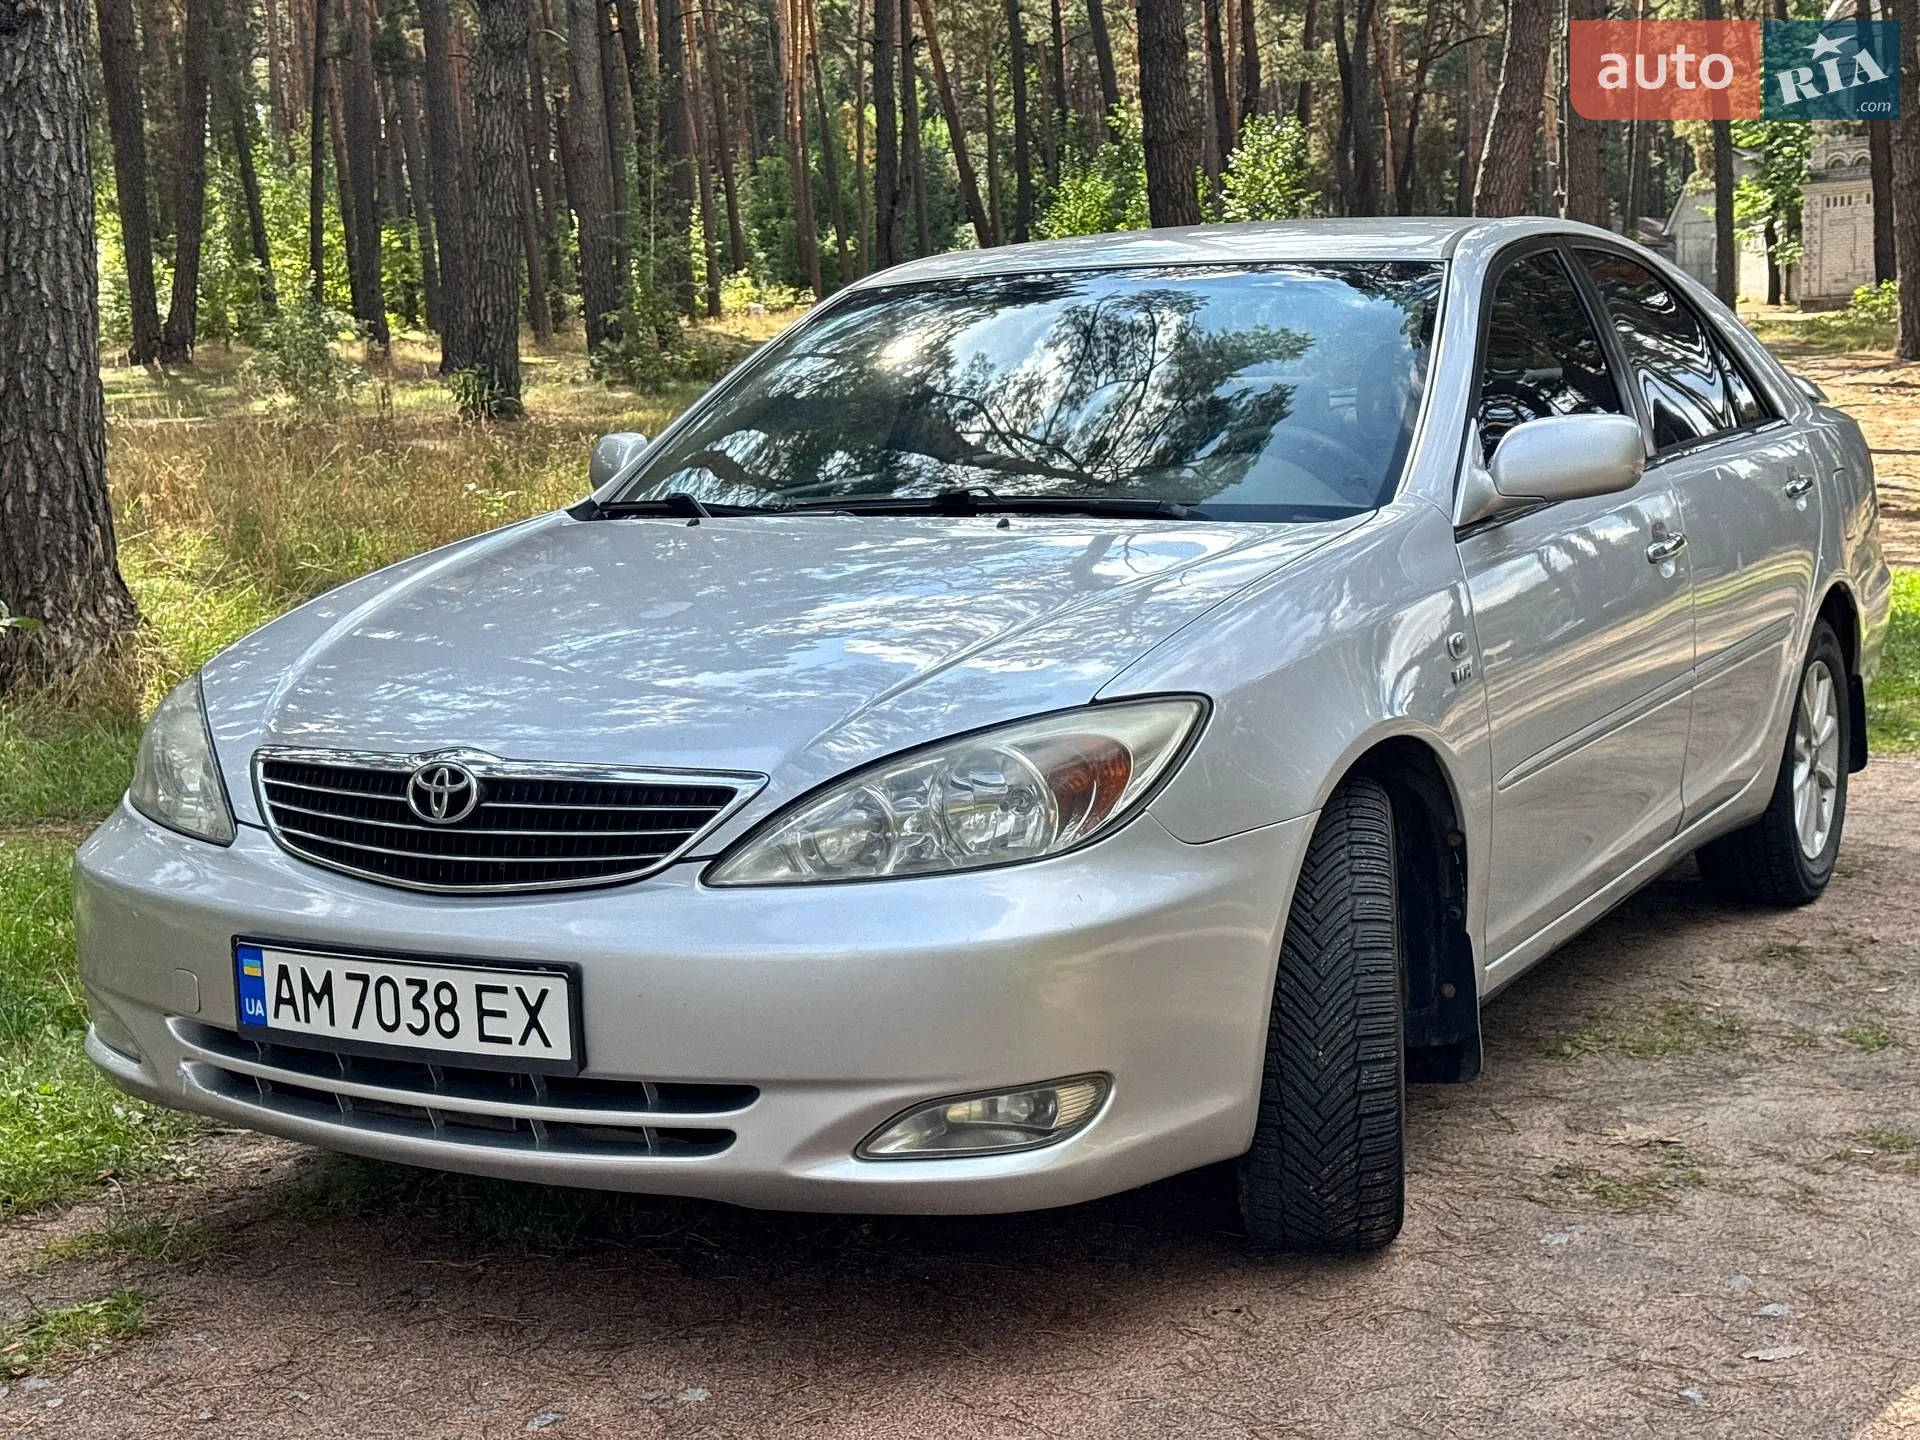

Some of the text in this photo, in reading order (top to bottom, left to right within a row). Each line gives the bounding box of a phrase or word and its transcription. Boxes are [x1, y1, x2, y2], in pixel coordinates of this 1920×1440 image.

[245, 997, 265, 1017] UA
[273, 963, 553, 1049] AM 7038 EX
